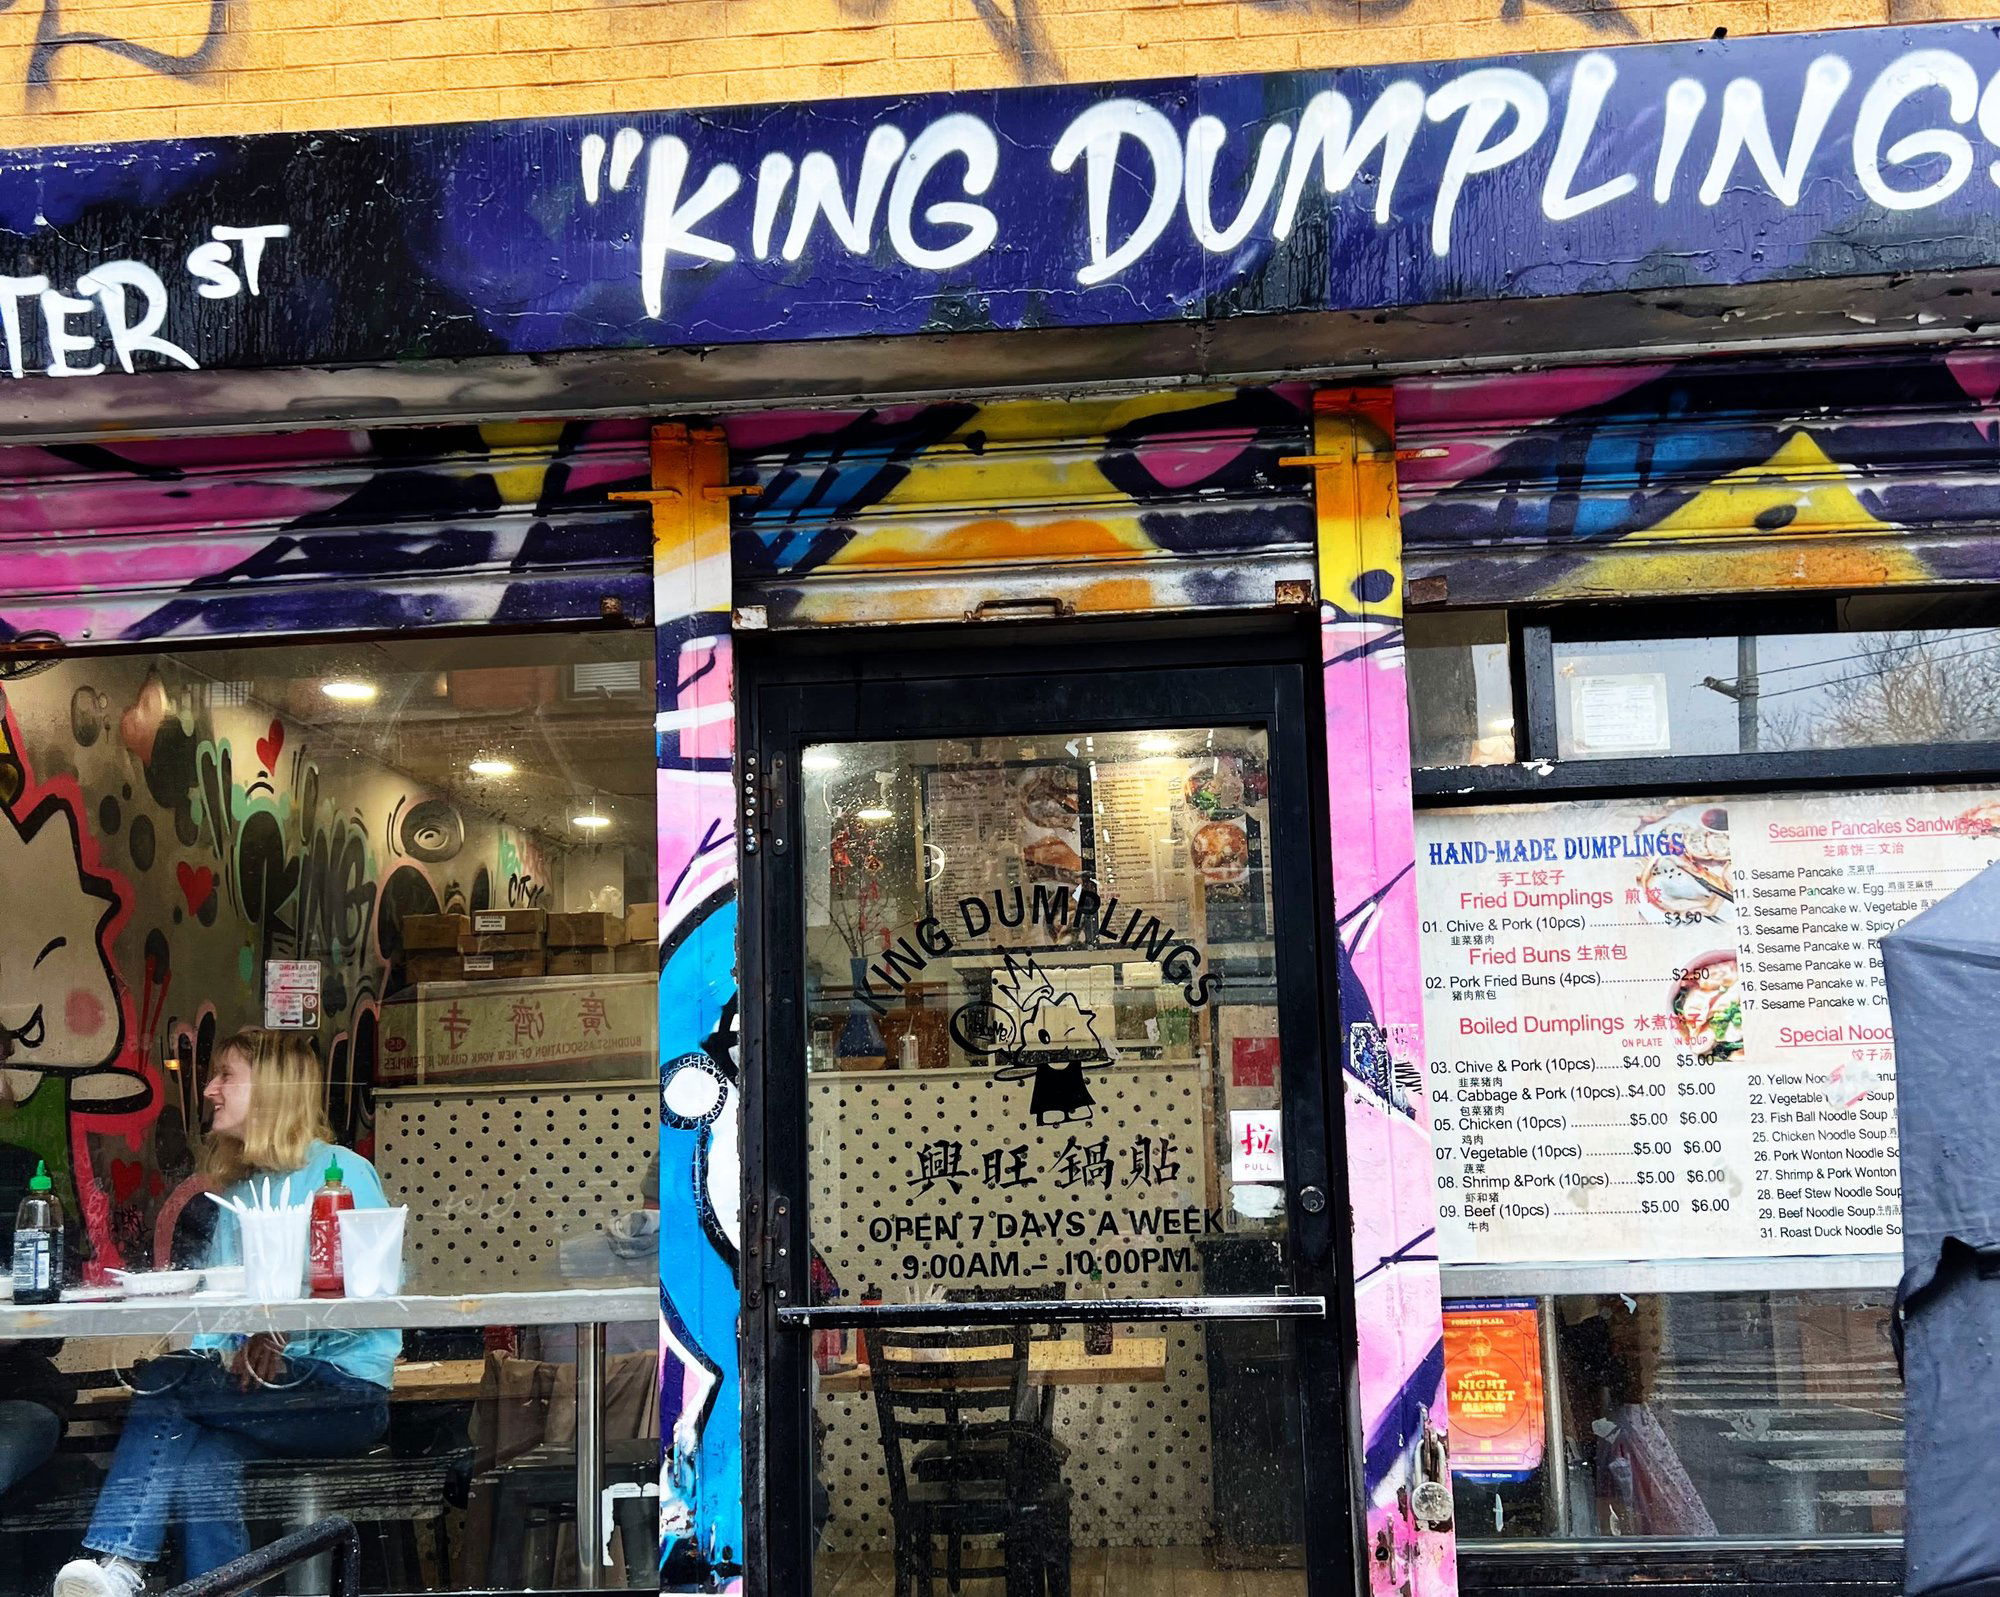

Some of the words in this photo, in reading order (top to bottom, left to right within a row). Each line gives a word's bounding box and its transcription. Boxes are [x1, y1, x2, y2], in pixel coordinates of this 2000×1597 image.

[1051, 48, 2000, 285] DUMPLING
[198, 225, 290, 300] ST
[1768, 822, 1827, 839] Sesame
[1832, 820, 1902, 836] Pancakes
[1906, 816, 1992, 833] Sandwiches
[1429, 838, 1557, 865] HAND-MADE
[1564, 833, 1687, 860] DUMPLINGS
[1823, 843, 1904, 857] 芝麻饼三文治
[1498, 869, 1565, 887] 手工饺子
[1751, 868, 1795, 880] Sesame
[1797, 866, 1843, 878] Pancake
[1460, 892, 1508, 910] Fried
[1513, 888, 1613, 909] Dumplings
[1752, 887, 1796, 898] Sesame
[1799, 884, 1845, 896] Pancake
[1863, 883, 1884, 896] Egg
[1754, 905, 1797, 917] Sesame
[1801, 903, 1846, 915] Pancake
[1864, 901, 1917, 913] Vegetable
[1422, 921, 1442, 933] 01.
[1446, 920, 1484, 932] Chive
[1488, 919, 1498, 931] &
[1502, 918, 1532, 930] Pork
[1536, 915, 1586, 932] (10pcs)
[1755, 924, 1799, 935] Sesame
[1802, 921, 1848, 933] Pancake
[1866, 920, 1894, 933] Spicy
[853, 916, 953, 1016] KING
[959, 885, 1222, 1007] DUMPLINGS
[1469, 947, 1517, 965] Fried
[1523, 946, 1571, 962] Buns
[1577, 945, 1627, 961] 生煎包
[1425, 976, 1446, 990] 02.
[1450, 975, 1480, 989] Pork
[1484, 974, 1518, 988] Fried
[1521, 973, 1555, 987] Buns
[1559, 970, 1601, 989] (4pcs)
[1672, 968, 1709, 981] $2.50
[1761, 999, 1805, 1010] Sesame
[1808, 996, 1854, 1007] Pancake
[1459, 1017, 1519, 1035] Boiled
[1524, 1014, 1624, 1034] Dumplings
[1622, 1039, 1634, 1048] ON
[1636, 1038, 1662, 1047] PLATE
[1780, 1026, 1843, 1046] Special
[1431, 1061, 1451, 1074] 03.
[1455, 1060, 1493, 1074] Chive
[1497, 1060, 1507, 1072] &
[1511, 1058, 1542, 1072] Pork
[1546, 1056, 1596, 1073] (10pcs)
[1623, 1055, 1661, 1068] $4.00
[1676, 1053, 1714, 1067] $5.00
[1767, 1073, 1802, 1085] Yellow
[1432, 1091, 1453, 1103] 04.
[1456, 1088, 1517, 1105] Cabbage
[1522, 1088, 1531, 1100] &
[1535, 1087, 1566, 1100] Pork
[1570, 1084, 1620, 1101] (10pcs)
[1628, 1084, 1665, 1097] $4.00
[1678, 1082, 1715, 1096] $5.00
[1769, 1092, 1822, 1106] Vegetable
[1867, 1090, 1894, 1101] Soup
[1434, 1119, 1454, 1131] 05.
[1458, 1118, 1512, 1130] Chicken
[1516, 1115, 1566, 1131] (10pcs)
[1630, 1112, 1668, 1126] $5.00
[1679, 1111, 1717, 1125] $6.00
[1771, 1112, 1792, 1123] Fish
[1796, 1111, 1815, 1122] Ball
[1819, 1110, 1856, 1121] Noodle
[1859, 1108, 1887, 1121] Soup
[1241, 1124, 1275, 1155] 拉
[1772, 1131, 1815, 1142] Chicken
[1818, 1129, 1856, 1140] Noodle
[1859, 1128, 1887, 1140] Soup
[1436, 1147, 1456, 1160] 07.
[1460, 1144, 1528, 1161] Vegetable
[1531, 1143, 1582, 1159] (10pcs)
[1634, 1141, 1672, 1155] $5.00
[1683, 1140, 1721, 1154] $6.00
[1774, 1150, 1799, 1161] Pork
[1801, 1149, 1843, 1160] Wonton
[1846, 1148, 1883, 1159] Noodle
[907, 1137, 1181, 1198] 興旺鍋貼
[1245, 1163, 1271, 1171] PULL
[1775, 1169, 1813, 1181] Shrimp
[1817, 1168, 1824, 1179] &
[1828, 1167, 1852, 1179] Pork
[1855, 1167, 1897, 1177] Wonton
[1438, 1176, 1458, 1189] 08.
[1463, 1175, 1510, 1190] Shrimp
[1559, 1172, 1610, 1188] (10pcs)
[1637, 1171, 1675, 1184] $5.00
[1687, 1169, 1725, 1183] $6.00
[1777, 1188, 1802, 1199] Beef
[1805, 1187, 1832, 1198] Stew
[1835, 1185, 1872, 1197] Noodle
[1440, 1205, 1460, 1218] 09.
[1464, 1204, 1495, 1217] Beef
[1499, 1202, 1550, 1218] (10pcs)
[1641, 1200, 1679, 1213] $5.00
[1691, 1199, 1729, 1212] $6.00
[1779, 1207, 1804, 1218] Beef
[1806, 1205, 1844, 1217] Noodle
[1848, 1204, 1875, 1218] Soup
[869, 1214, 958, 1242] OPEN
[969, 1215, 984, 1240] 7
[997, 1210, 1086, 1238] DAYS
[1097, 1211, 1120, 1235] A
[1129, 1208, 1224, 1235] WEEK
[1780, 1226, 1812, 1238] Roast
[1815, 1225, 1842, 1236] Duck
[1845, 1223, 1883, 1235] Noodle
[903, 1252, 1019, 1279] 9:00AM
[1065, 1247, 1191, 1275] 10:00PM
[1458, 1380, 1507, 1390] NIGHT
[1451, 1390, 1516, 1401] MARKET
